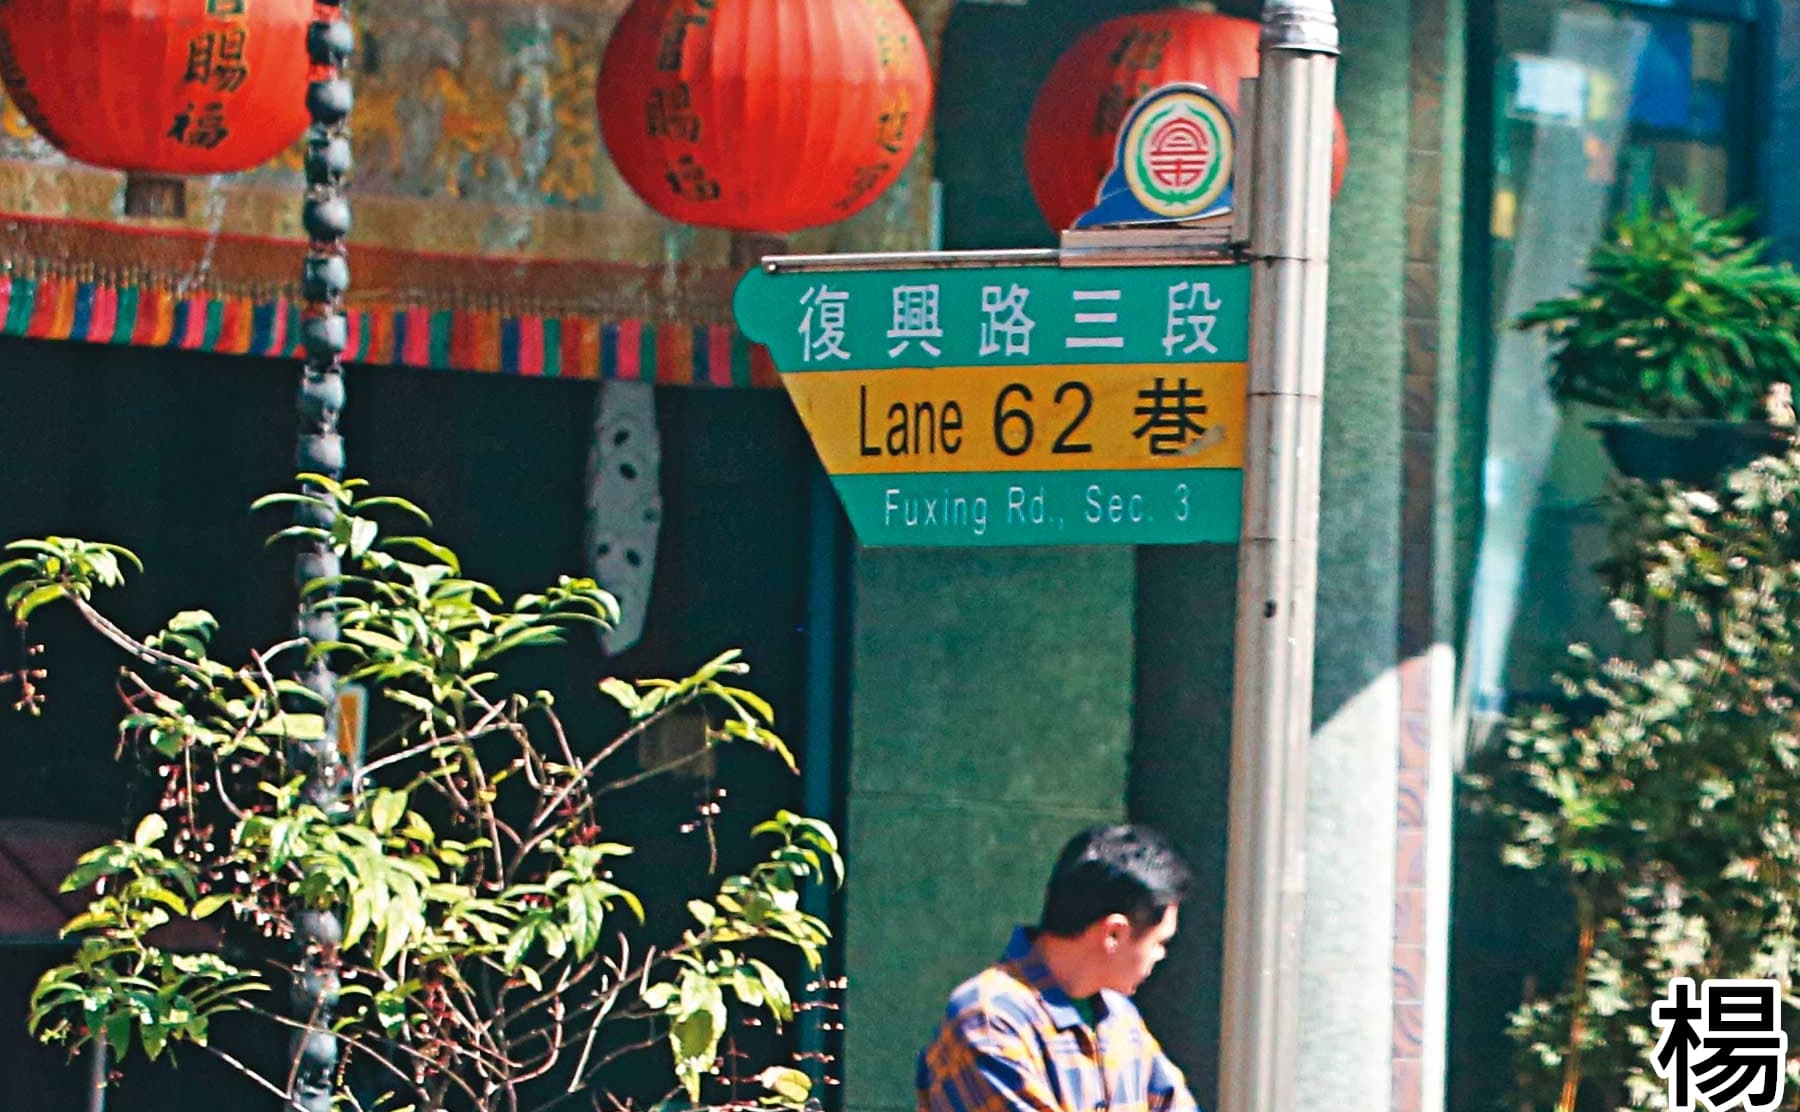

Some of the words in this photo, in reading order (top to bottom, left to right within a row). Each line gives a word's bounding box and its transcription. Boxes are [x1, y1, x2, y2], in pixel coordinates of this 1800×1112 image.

[798, 280, 1222, 361] 復興路三段
[858, 384, 964, 457] Lane
[993, 382, 1094, 456] 62
[1132, 377, 1209, 456] 巷
[884, 488, 987, 535] Fuxing
[1085, 484, 1154, 525] Sec.
[1174, 482, 1191, 522] 3
